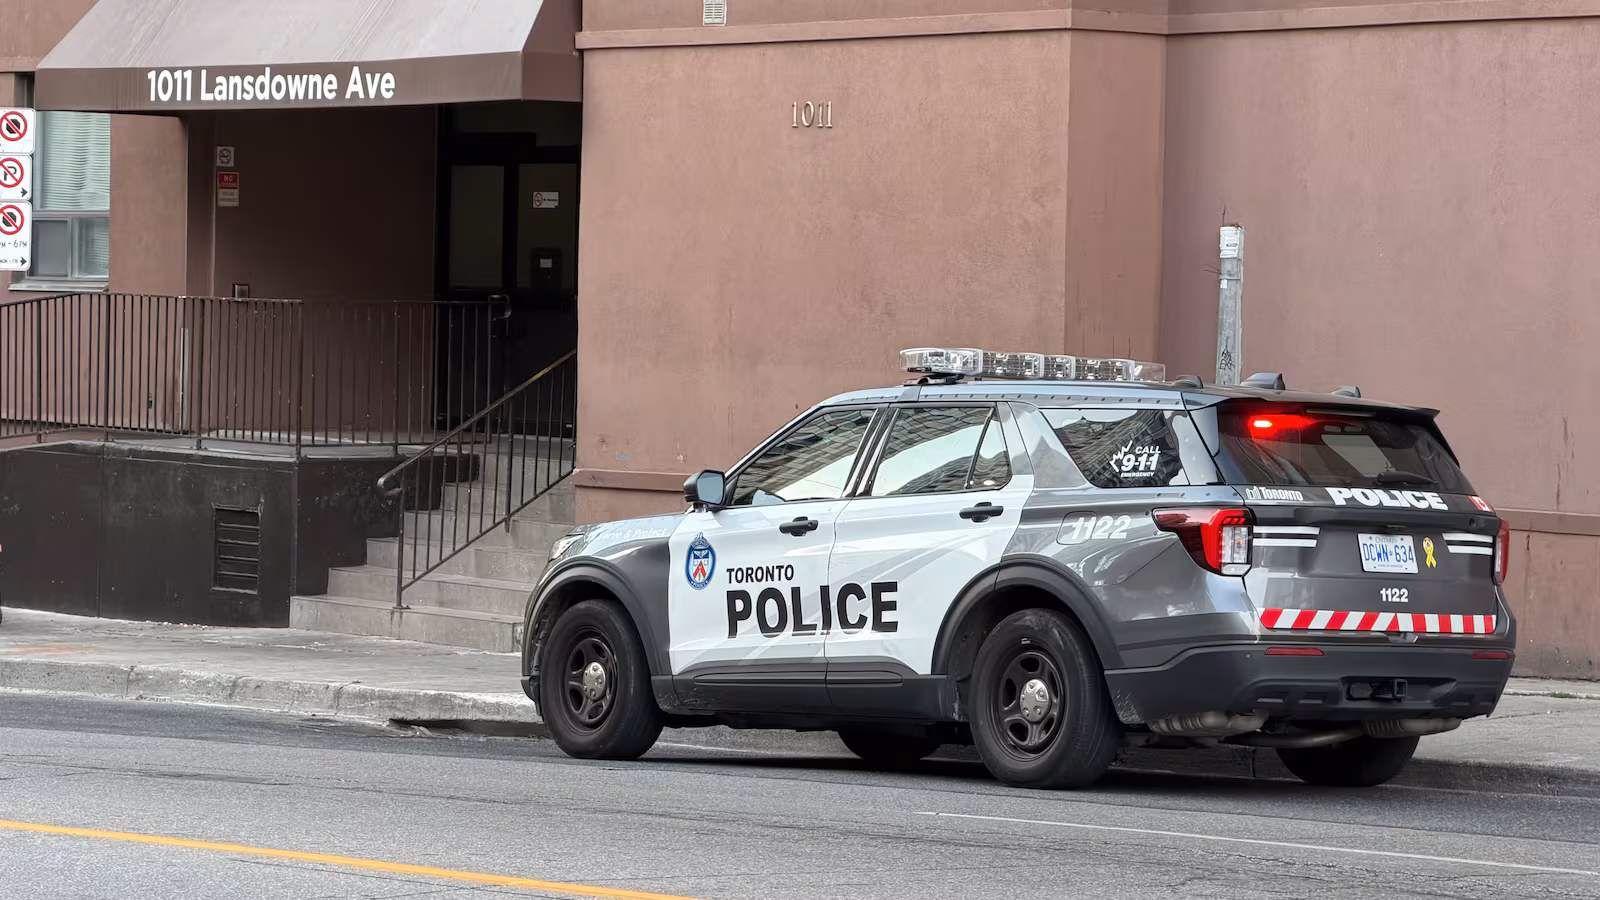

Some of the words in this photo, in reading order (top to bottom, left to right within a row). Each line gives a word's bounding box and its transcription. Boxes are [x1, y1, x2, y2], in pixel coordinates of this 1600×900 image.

[148, 69, 192, 101] 1011
[200, 67, 338, 101] Lansdowne
[345, 66, 396, 99] Ave
[791, 100, 833, 128] 1011
[223, 174, 233, 182] NO
[1135, 446, 1161, 454] CALL
[1259, 486, 1304, 501] TORONTO
[1324, 487, 1449, 511] POLICE
[632, 528, 667, 538] Protect
[1072, 515, 1132, 540] 1122
[726, 564, 794, 584] TORONTO
[1380, 588, 1409, 603] 1122
[726, 581, 899, 639] POLICE
